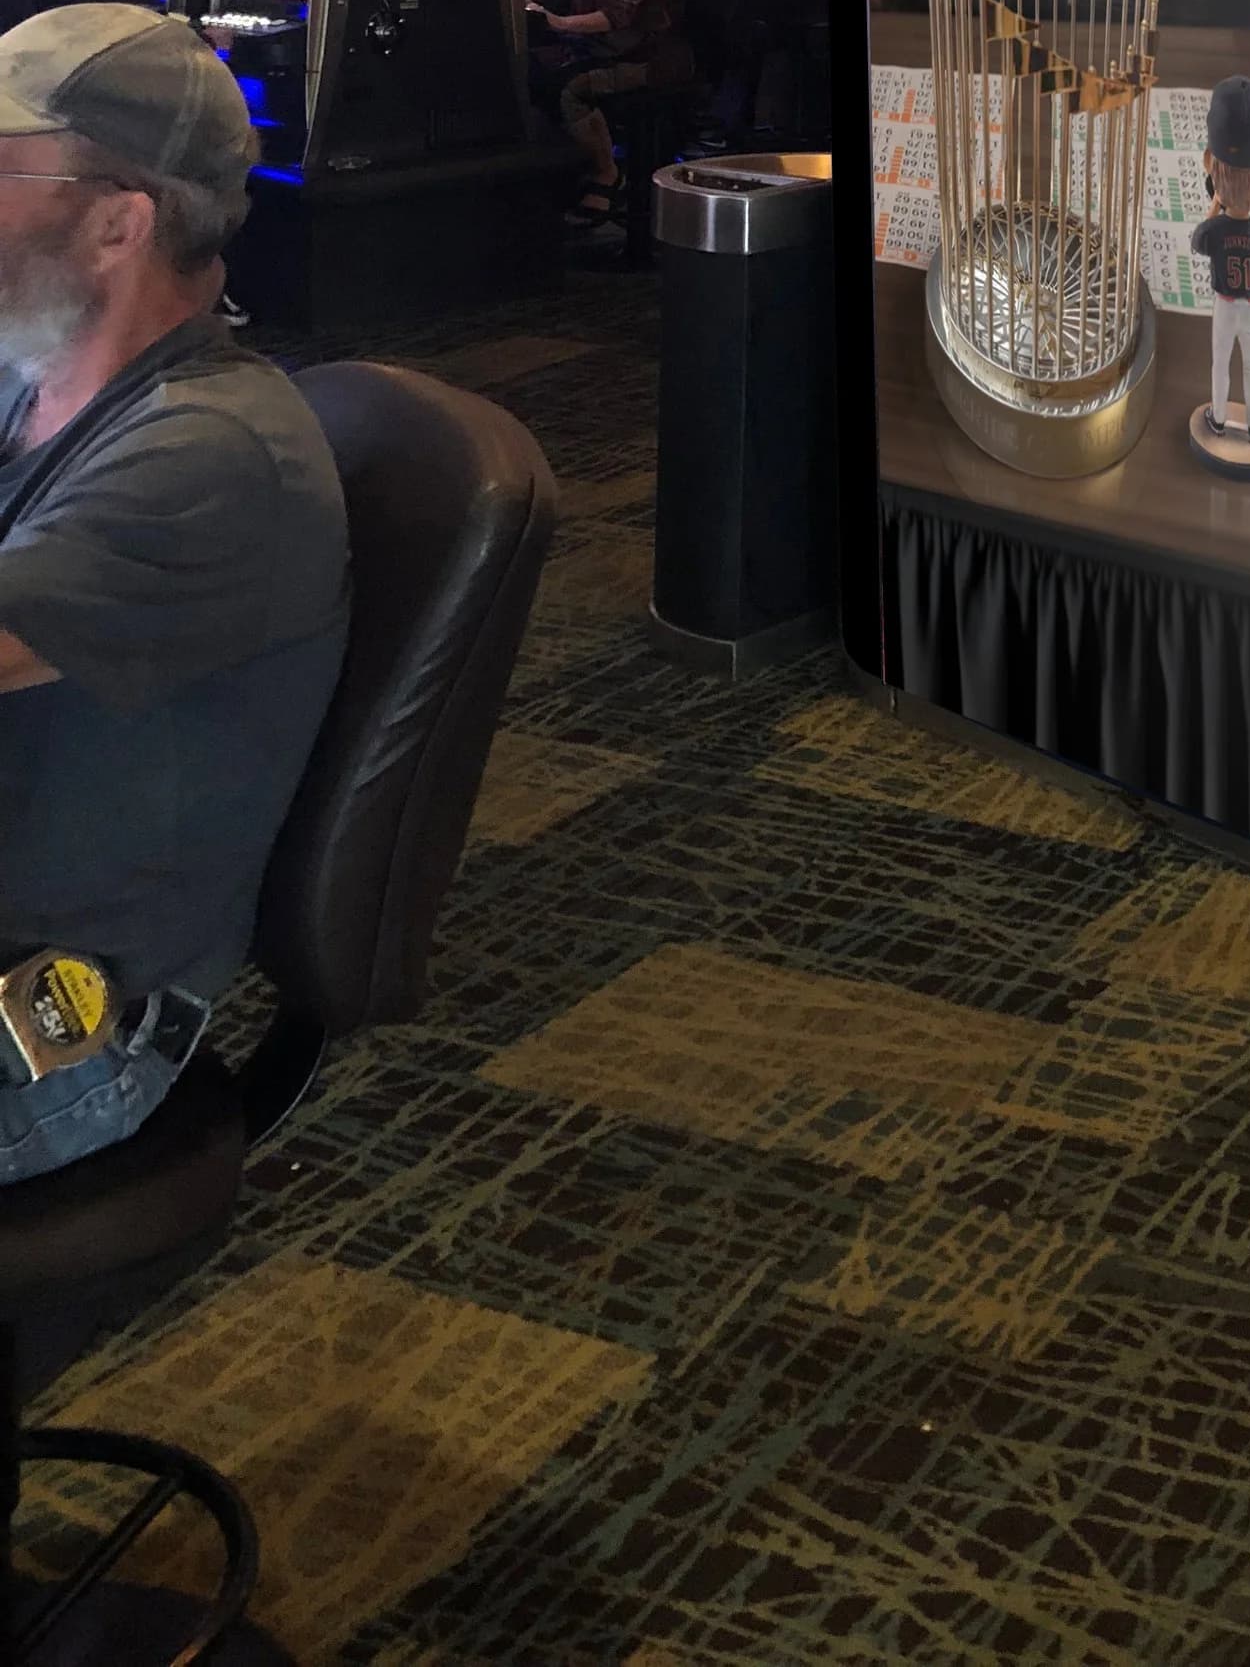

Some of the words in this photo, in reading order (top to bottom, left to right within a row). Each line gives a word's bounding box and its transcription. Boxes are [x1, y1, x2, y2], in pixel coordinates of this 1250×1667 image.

[893, 206, 908, 214] 68
[912, 209, 928, 217] 59
[891, 217, 905, 225] 74
[889, 228, 904, 236] 65
[908, 231, 923, 240] 50
[906, 243, 921, 251] 54
[1154, 242, 1170, 251] 10
[1161, 268, 1170, 278] 9
[1163, 282, 1172, 290] 5
